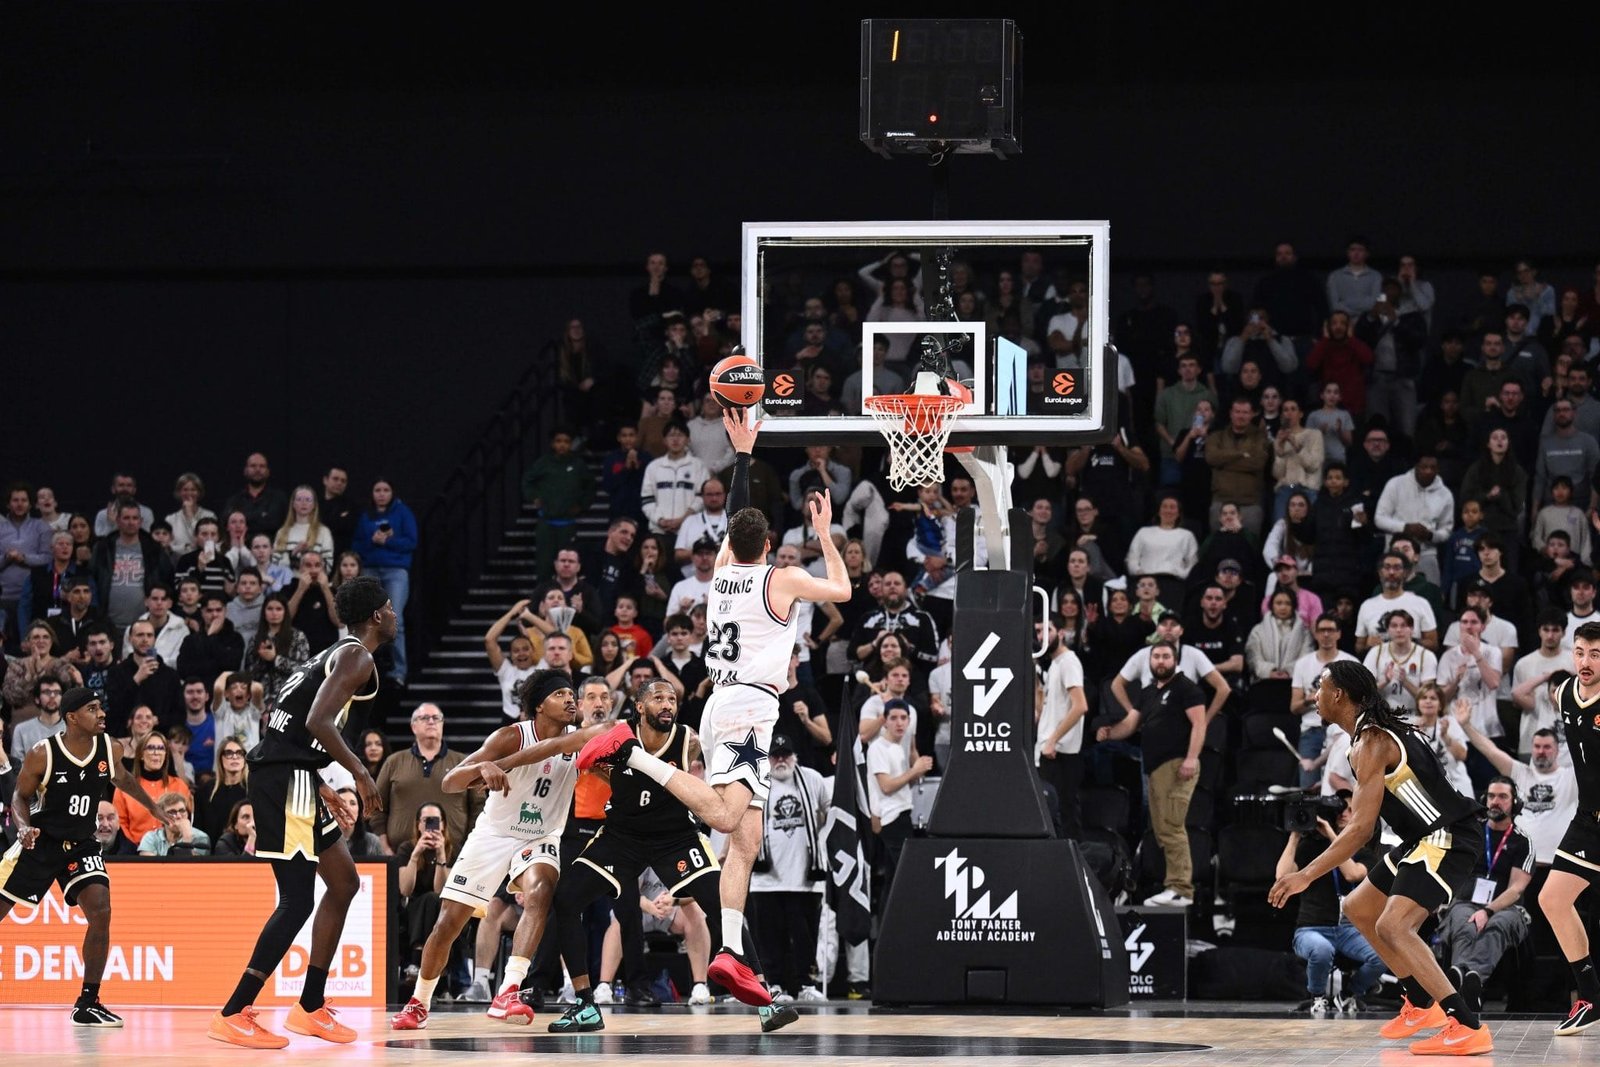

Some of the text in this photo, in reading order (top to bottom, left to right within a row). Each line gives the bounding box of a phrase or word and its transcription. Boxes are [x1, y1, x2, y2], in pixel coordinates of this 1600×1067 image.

[765, 398, 802, 406] EuroLeague
[1044, 397, 1082, 405] EuroLeague
[963, 722, 1011, 738] LDLC
[963, 740, 1011, 752] ASVEL
[533, 777, 552, 798] 16
[639, 790, 651, 807] 6
[68, 795, 91, 816] 30
[510, 825, 545, 836] plenitude
[538, 842, 558, 857] 16
[82, 855, 104, 872] 30
[688, 848, 705, 868] 6
[951, 920, 1021, 930] TONY PARKER
[987, 931, 1035, 942] ACADEMY
[1129, 975, 1153, 985] DLC
